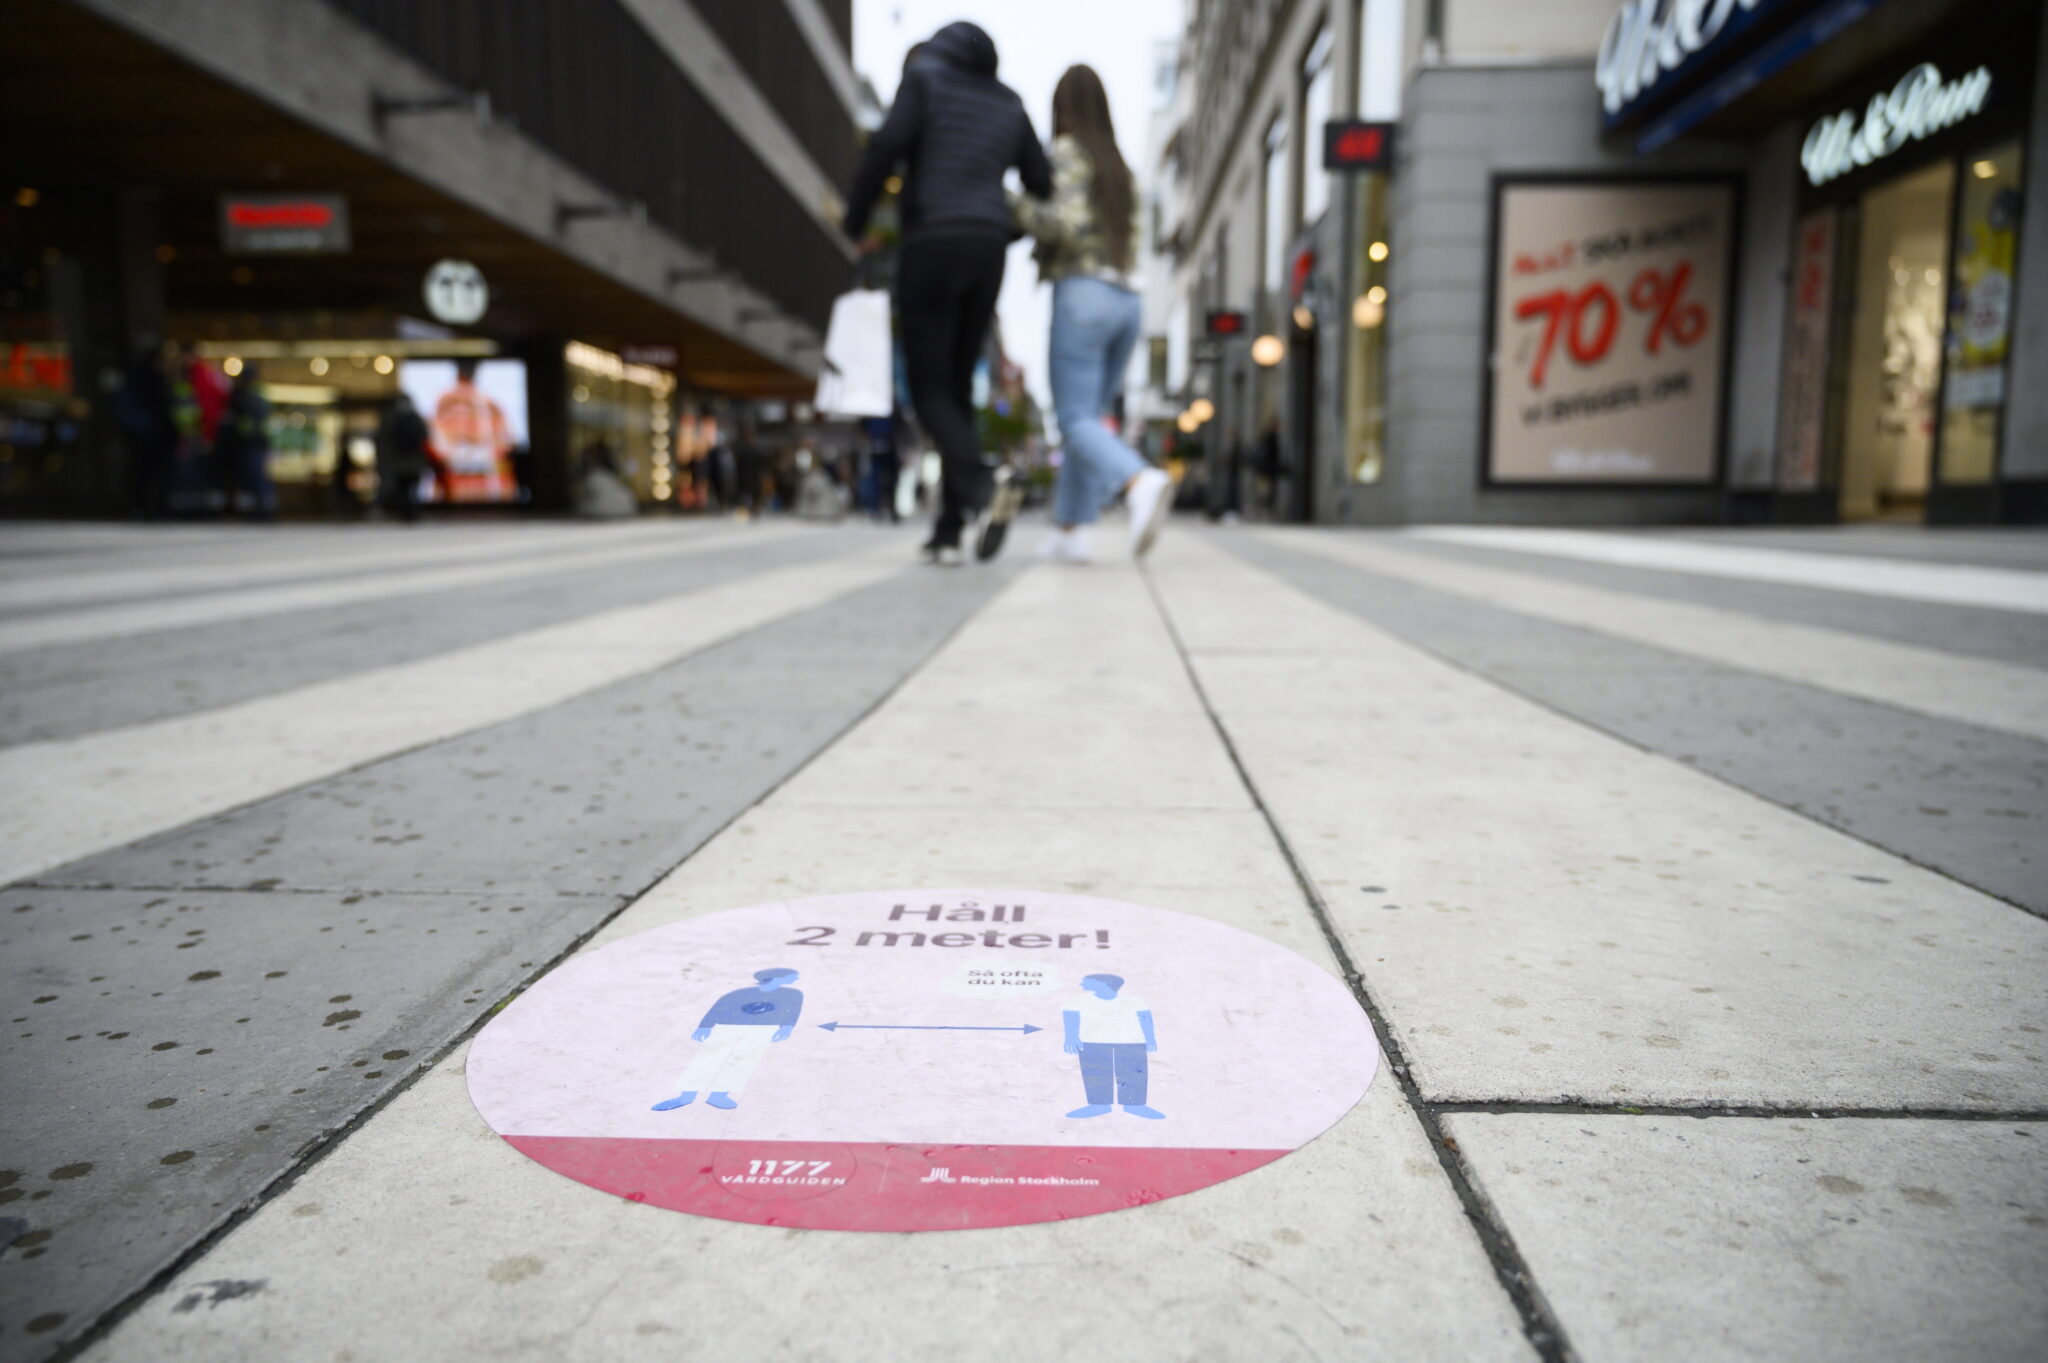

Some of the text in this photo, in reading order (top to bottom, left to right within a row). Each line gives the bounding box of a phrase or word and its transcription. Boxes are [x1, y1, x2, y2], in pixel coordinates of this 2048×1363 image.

[1514, 258, 1709, 392] 70%
[888, 901, 1026, 923] Håll
[785, 926, 1111, 950] 2 meter!
[748, 1160, 832, 1176] 1177
[721, 1174, 846, 1186] VÅRDGUIDEN
[960, 1175, 1100, 1187] Region Stockholm
